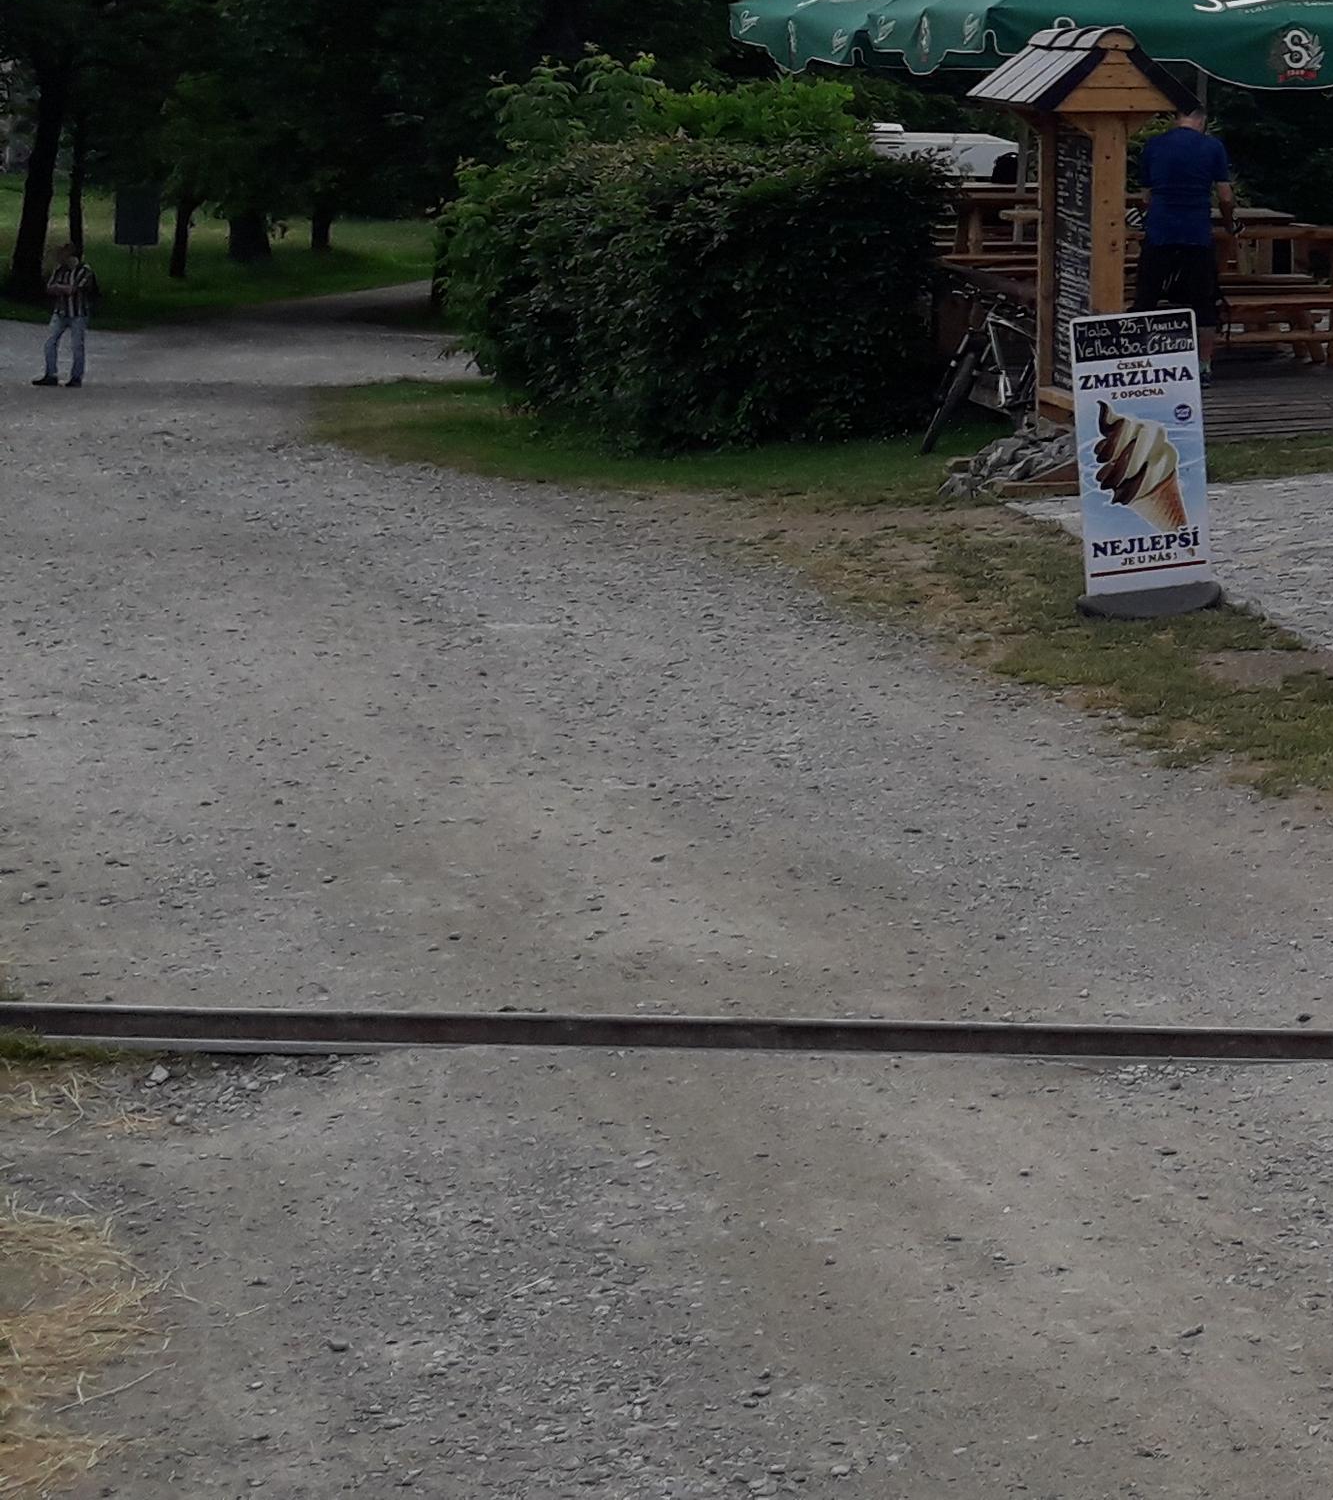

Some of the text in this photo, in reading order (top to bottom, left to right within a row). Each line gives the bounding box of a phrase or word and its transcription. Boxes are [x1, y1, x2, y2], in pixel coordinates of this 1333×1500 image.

[1076, 322, 1111, 338] Malá
[1117, 359, 1153, 370] ČESKÁ
[1079, 366, 1193, 391] ZMRZLINA
[1111, 392, 1118, 400] Z
[1092, 526, 1200, 558] NEJLEPŠÍ
[1121, 556, 1135, 566] JE
[1138, 555, 1146, 564] U
